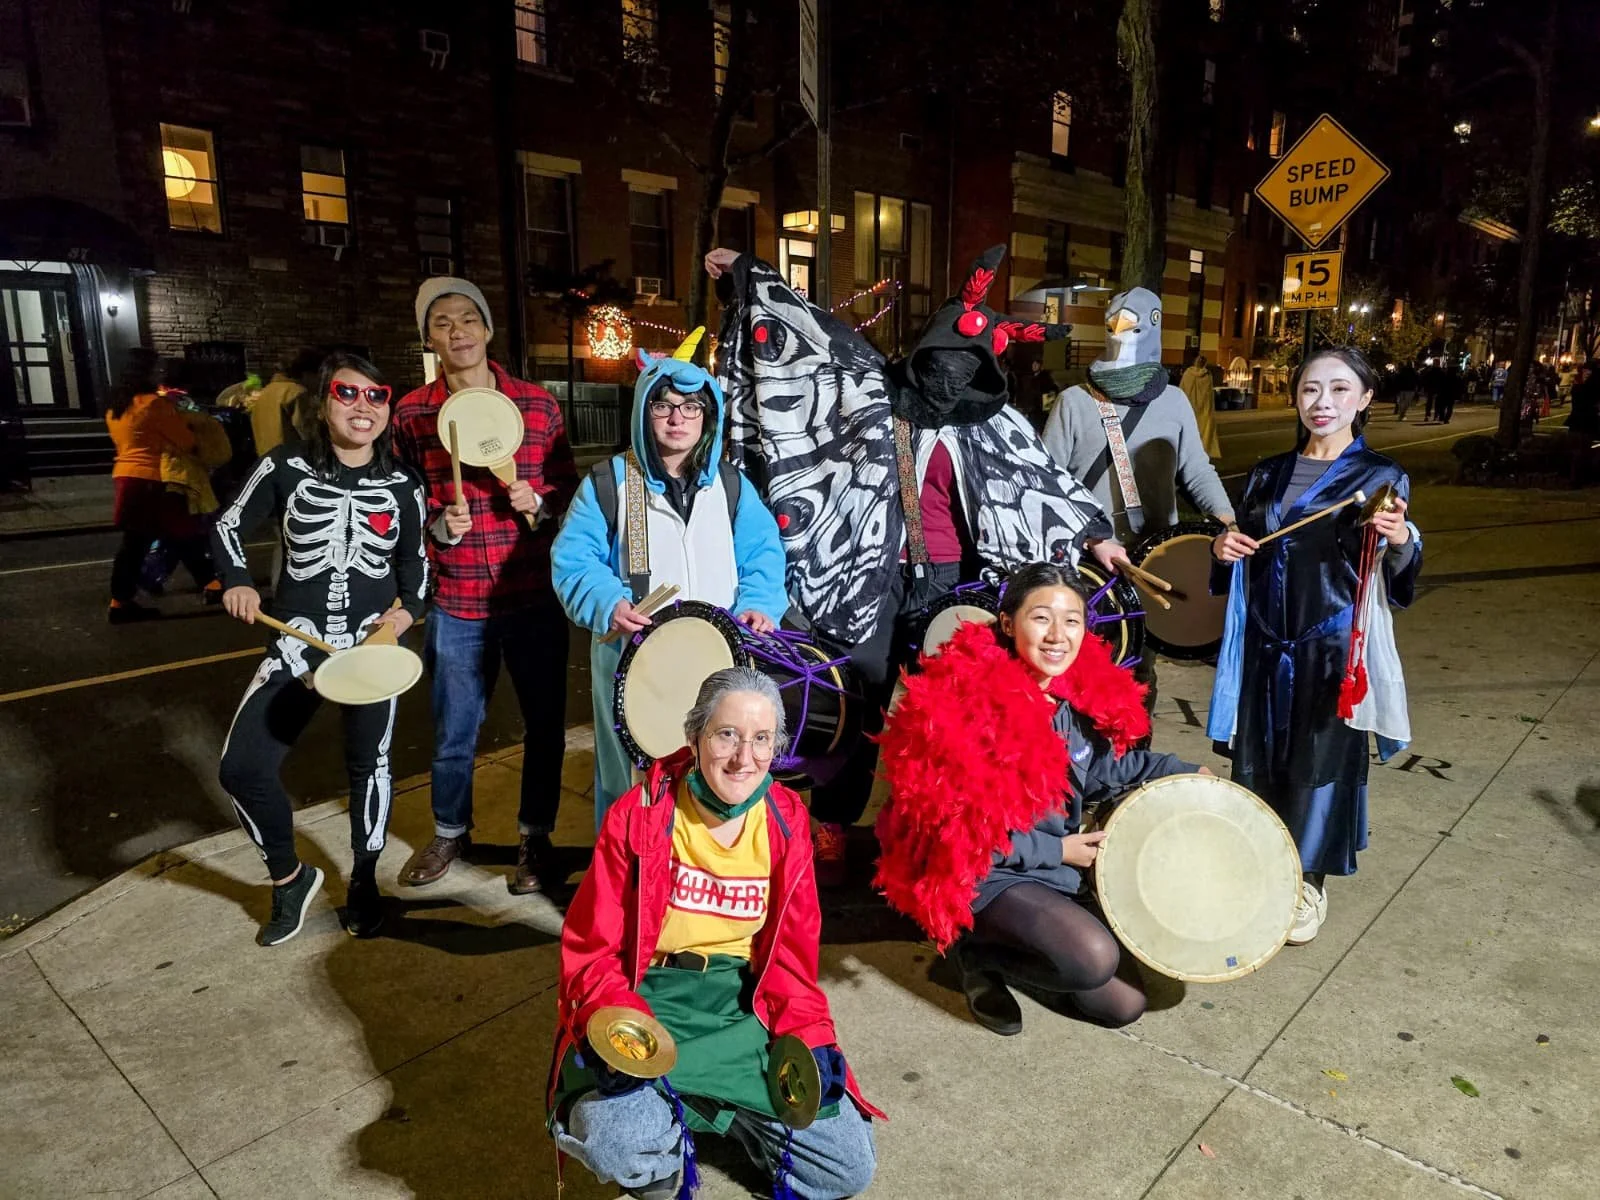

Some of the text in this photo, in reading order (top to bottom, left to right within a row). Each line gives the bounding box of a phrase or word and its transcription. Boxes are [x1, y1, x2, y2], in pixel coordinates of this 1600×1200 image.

[1287, 158, 1355, 183] SPEED
[1289, 183, 1349, 207] BUMP
[1295, 258, 1330, 286] 15
